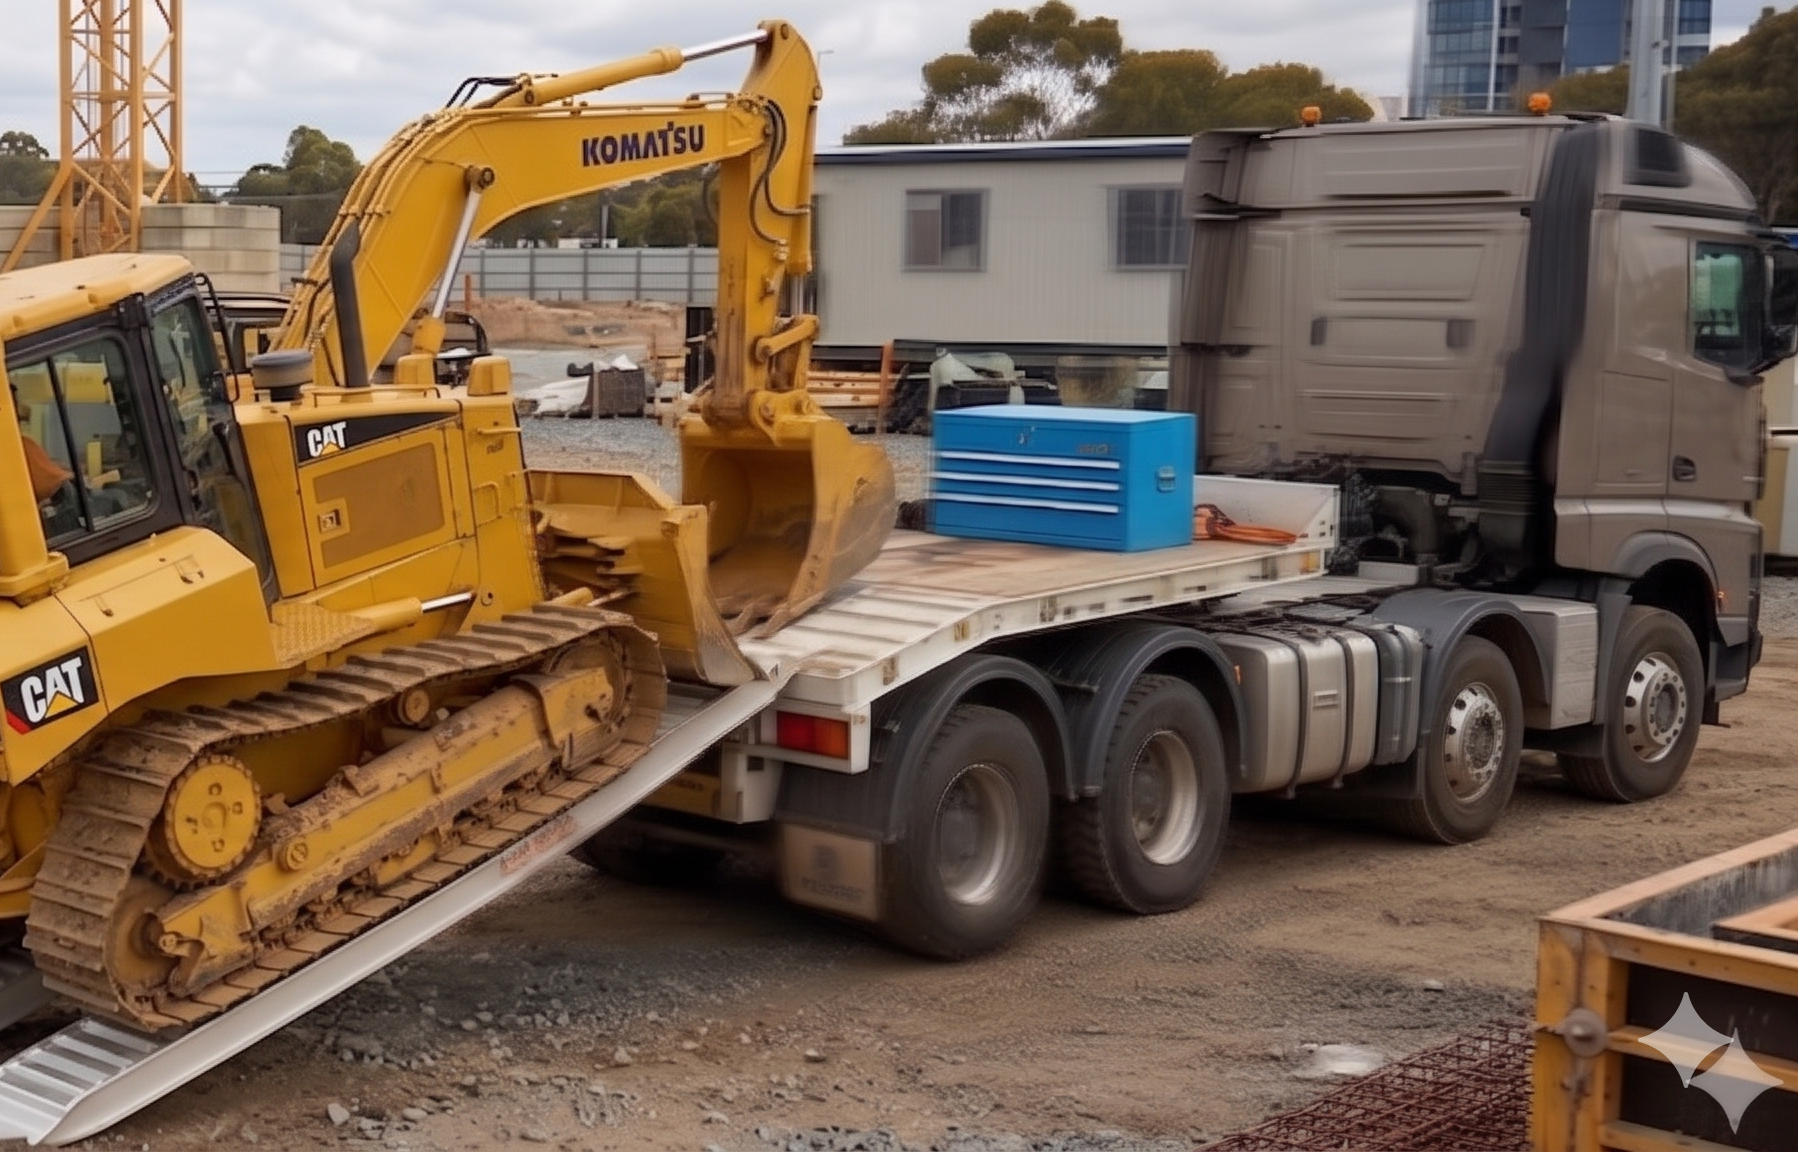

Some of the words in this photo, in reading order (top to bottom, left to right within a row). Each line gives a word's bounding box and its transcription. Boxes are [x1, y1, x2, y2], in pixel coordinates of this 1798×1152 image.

[582, 121, 704, 167] KOMATSU
[307, 421, 347, 457] CAT
[20, 656, 84, 723] CAT
